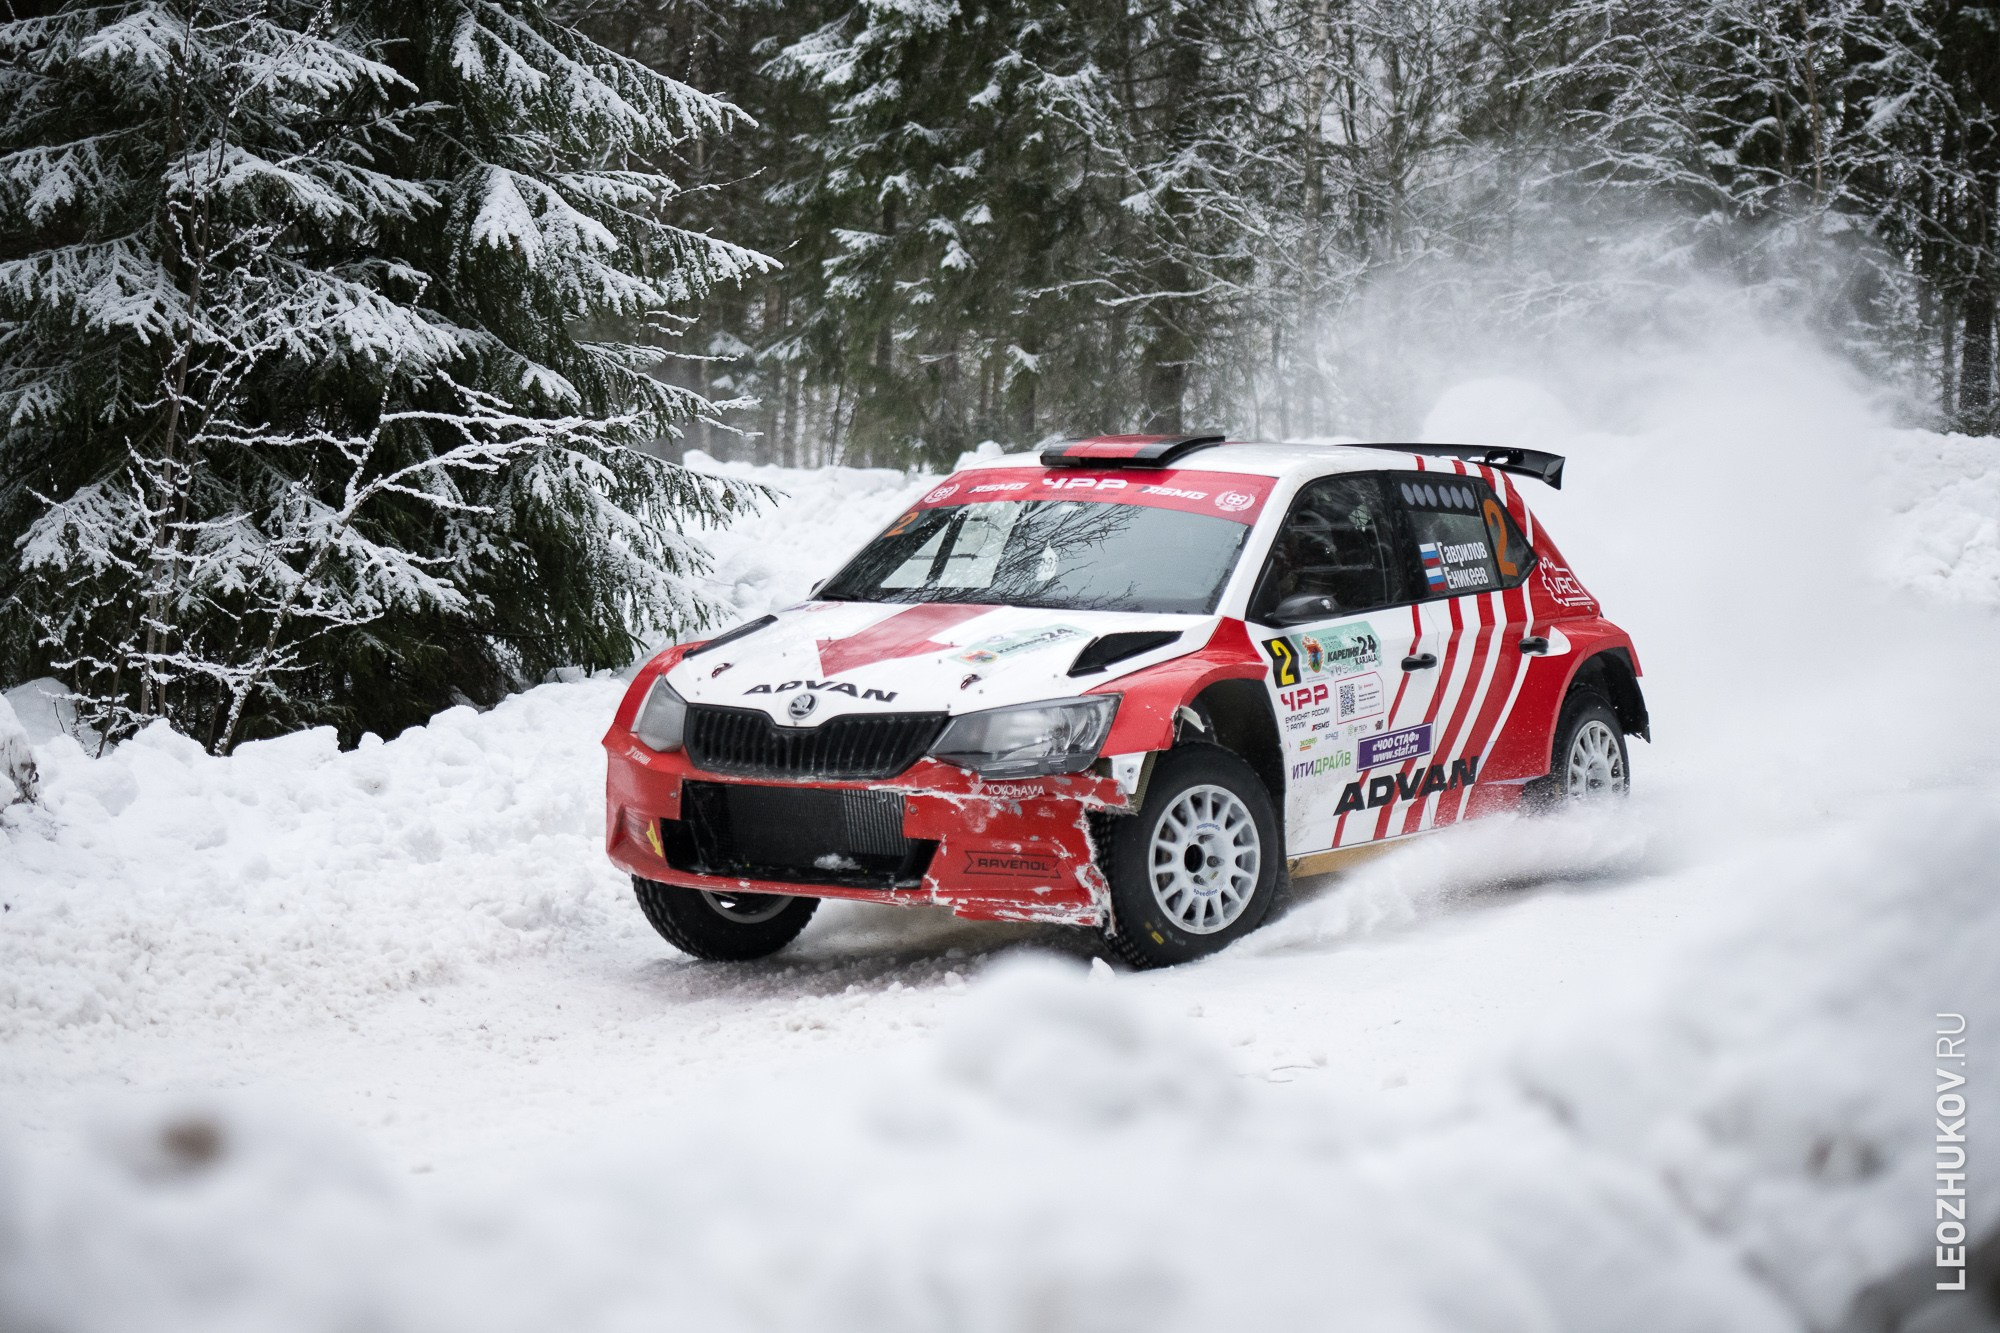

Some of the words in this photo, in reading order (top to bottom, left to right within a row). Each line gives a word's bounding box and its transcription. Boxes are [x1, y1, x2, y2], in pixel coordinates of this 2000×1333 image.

[884, 511, 920, 538] 2
[1483, 498, 1518, 577] 2
[1437, 541, 1488, 567] Гаврилов
[1443, 566, 1489, 590] Еникеев
[1271, 639, 1295, 686] 2
[1327, 646, 1360, 662] КАРЕЛИЯ
[1354, 654, 1378, 665] KARJALA
[742, 680, 899, 703] ADVAN
[1394, 731, 1419, 747] СТАФ»
[1372, 744, 1418, 763] www.staf.ru
[1333, 755, 1479, 816] ADVAN
[978, 858, 1050, 871] RAVENOL
